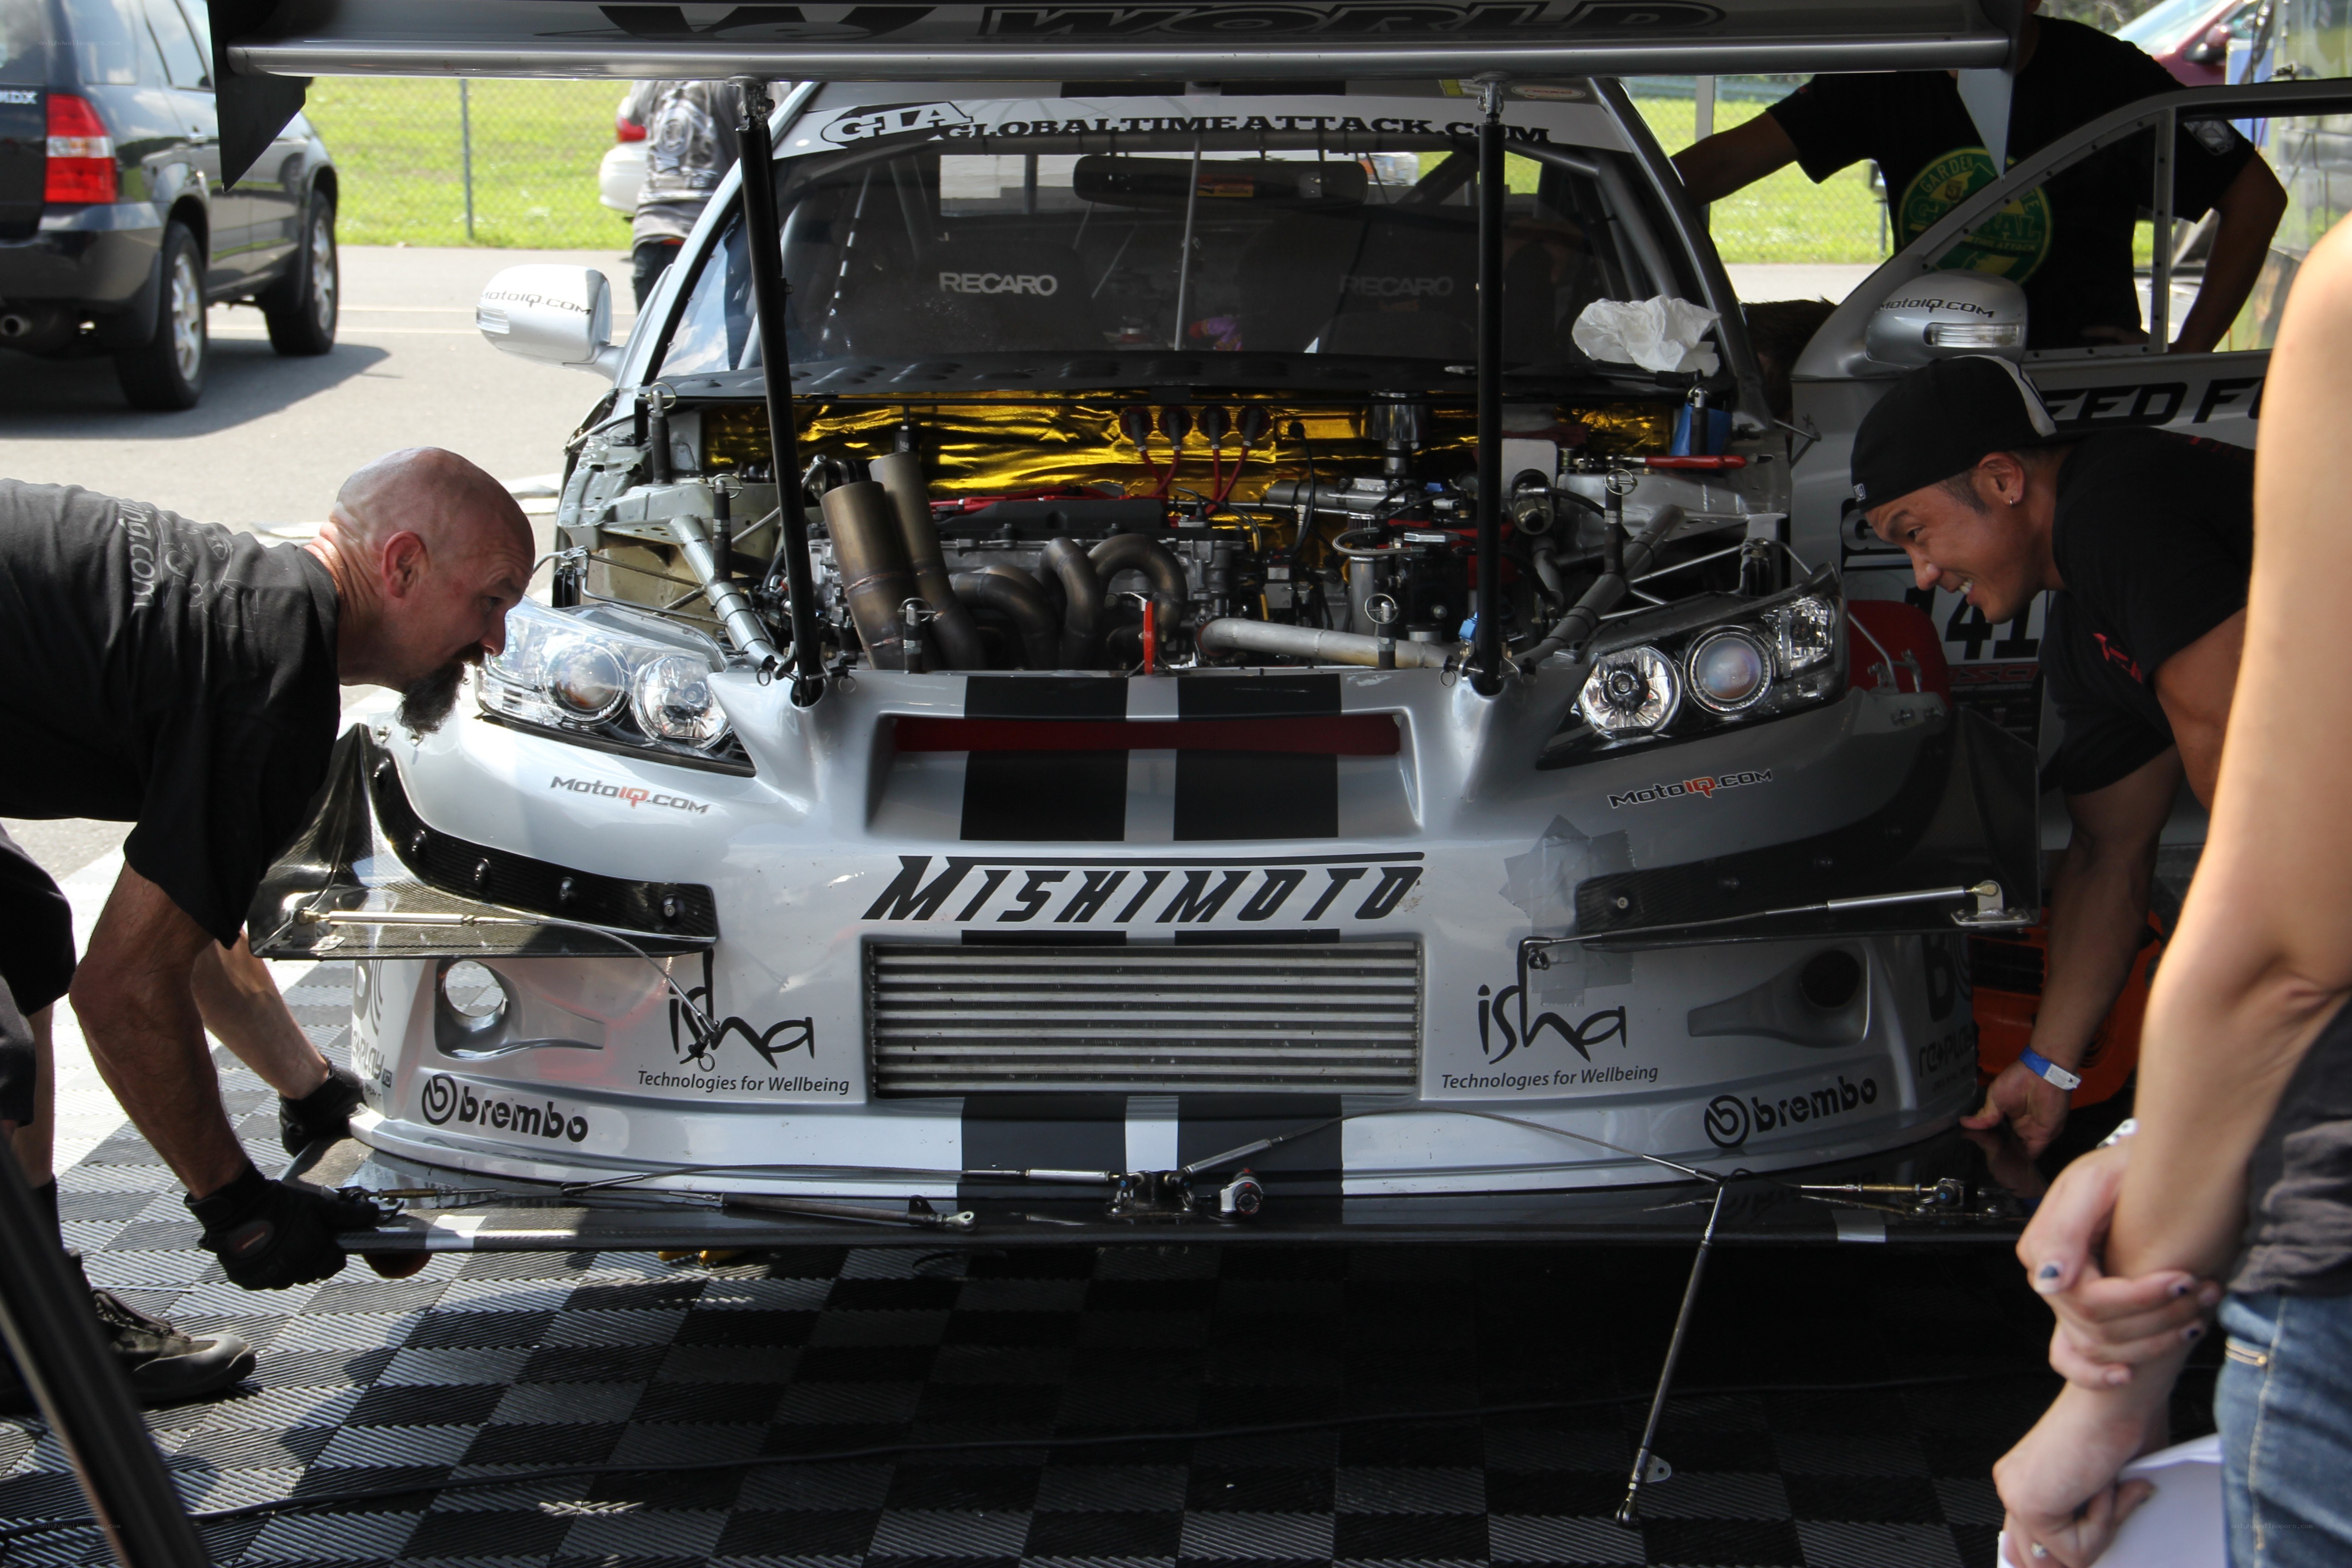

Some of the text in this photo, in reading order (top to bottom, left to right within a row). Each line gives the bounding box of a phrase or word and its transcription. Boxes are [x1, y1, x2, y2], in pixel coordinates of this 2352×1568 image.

[822, 102, 972, 142] GTA
[1920, 157, 1973, 193] GARDEN
[939, 272, 1058, 297] RECARO
[1339, 275, 1453, 297] RECARO
[861, 852, 1425, 923] MISHIMOTO
[1477, 939, 1626, 1065] isha
[637, 1070, 849, 1095] Technologies for Wellbeing
[1442, 1066, 1658, 1090] Technologies for Wellbeing
[458, 1086, 588, 1143] brembo
[1751, 1075, 1877, 1132] brembo
